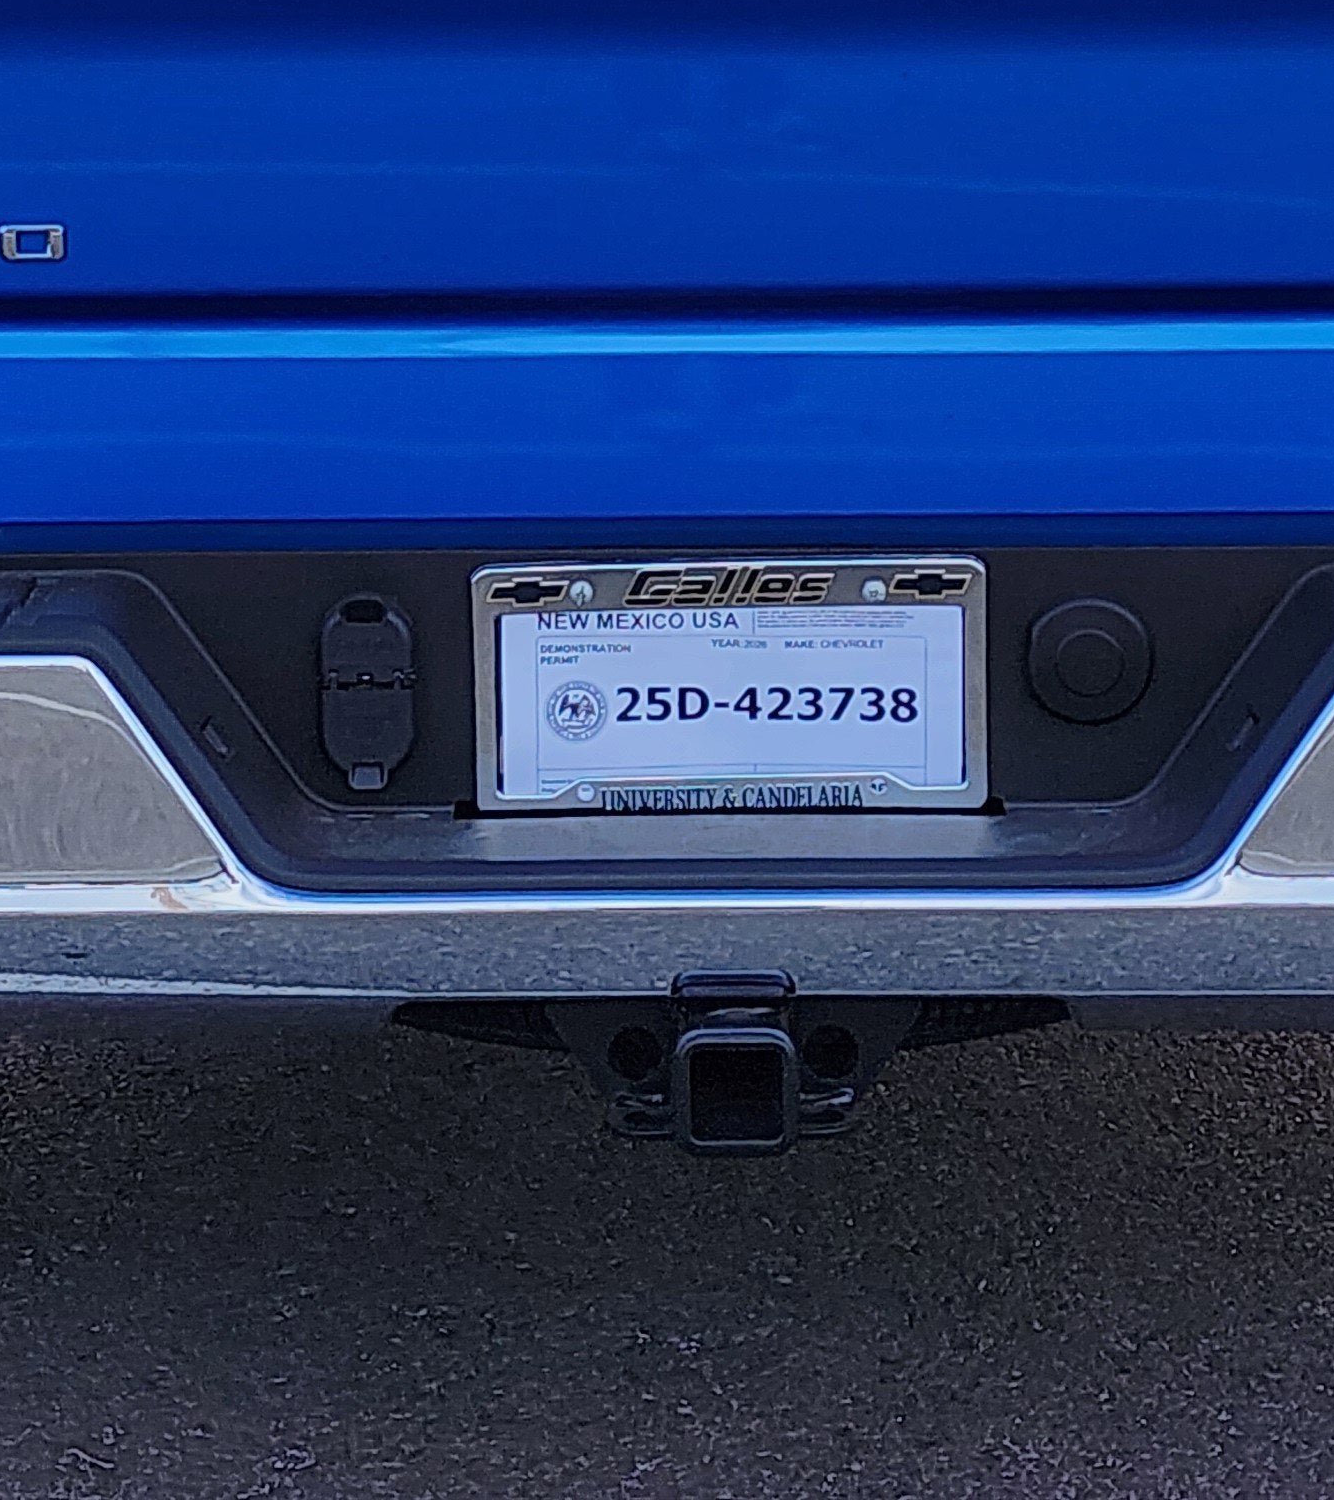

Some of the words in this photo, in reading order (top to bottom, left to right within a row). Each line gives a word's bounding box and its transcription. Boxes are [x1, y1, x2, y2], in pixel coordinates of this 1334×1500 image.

[536, 612, 590, 631] NEW
[596, 611, 685, 630] MEXICO
[692, 610, 740, 630] USA
[540, 643, 632, 654] DEMONSTRATION
[819, 638, 884, 649] CHEVROLET
[540, 655, 580, 665] PERMIT
[615, 686, 919, 723] 25D-423738
[601, 787, 718, 811] UNIVERSITY
[722, 786, 738, 809] &
[742, 783, 864, 809] CANDELARIA
